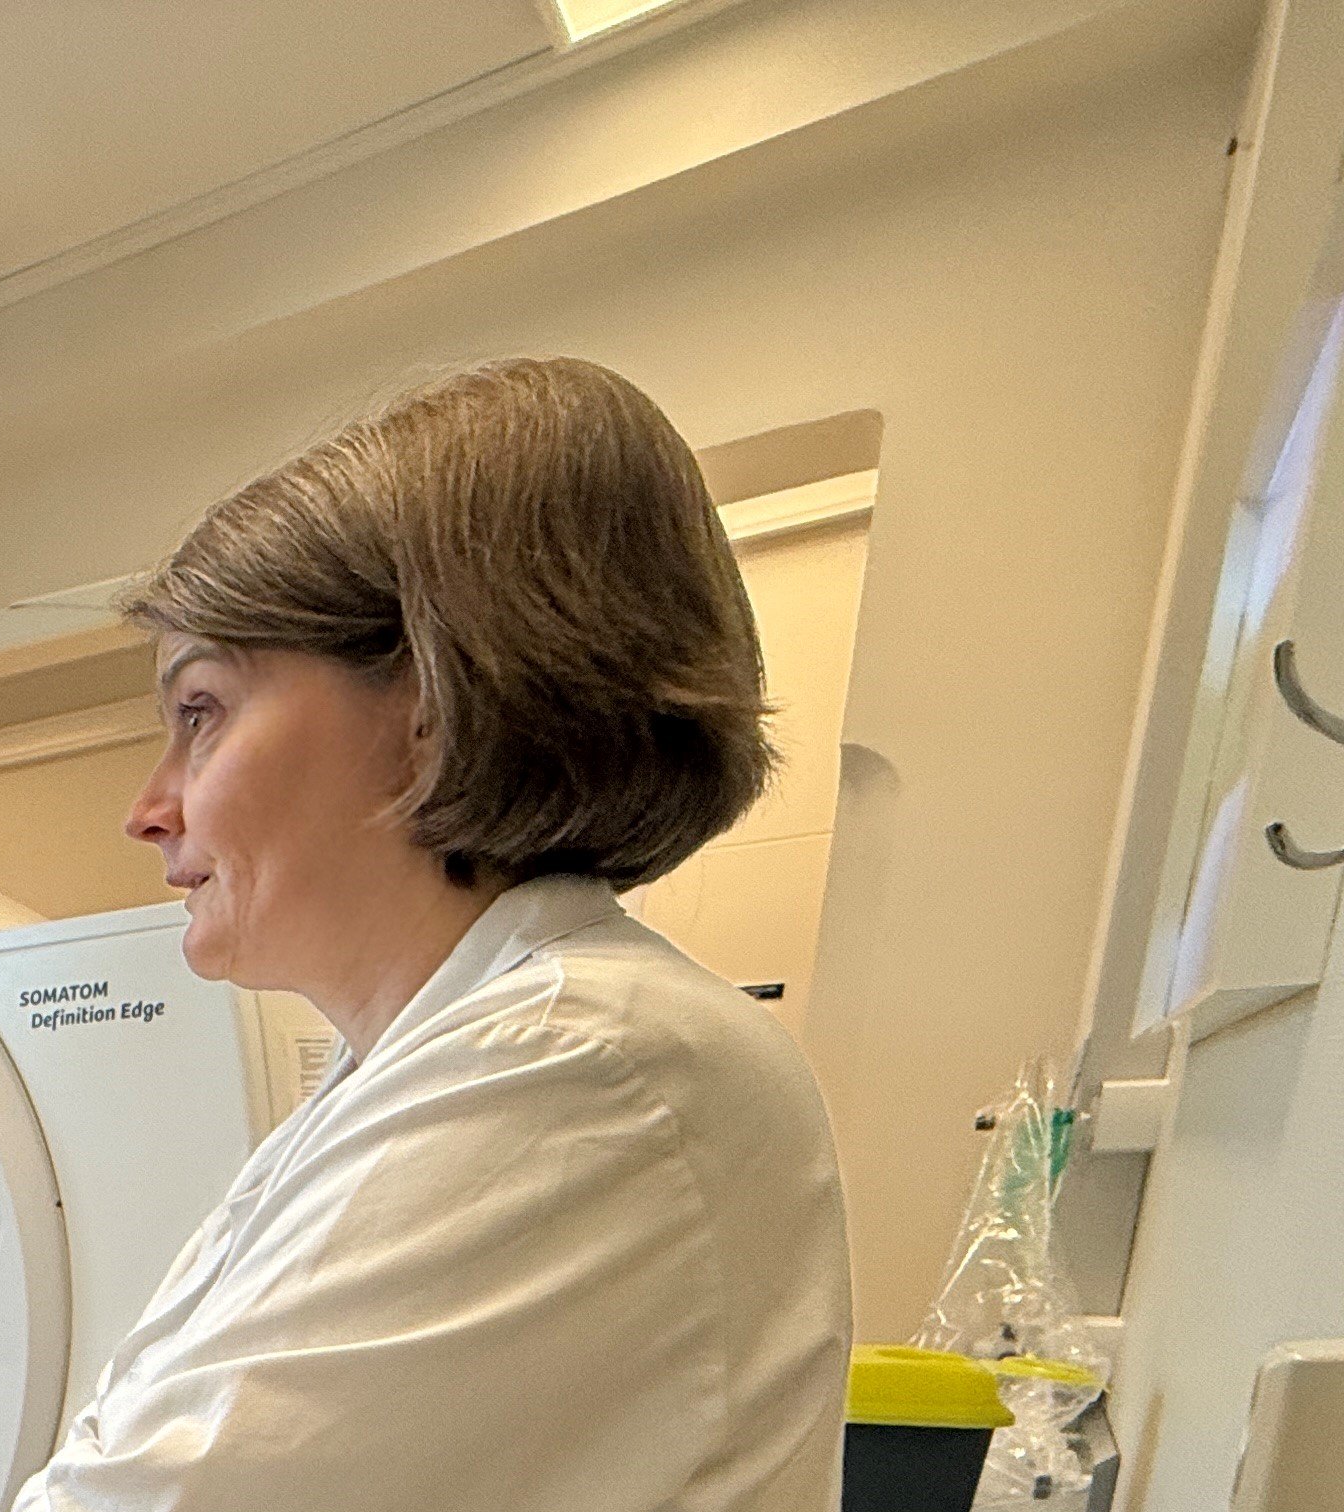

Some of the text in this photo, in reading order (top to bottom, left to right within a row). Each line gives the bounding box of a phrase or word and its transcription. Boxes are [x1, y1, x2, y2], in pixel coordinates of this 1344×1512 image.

[19, 981, 108, 1007] SOMATOM
[31, 1001, 165, 1031] Definition Edge
